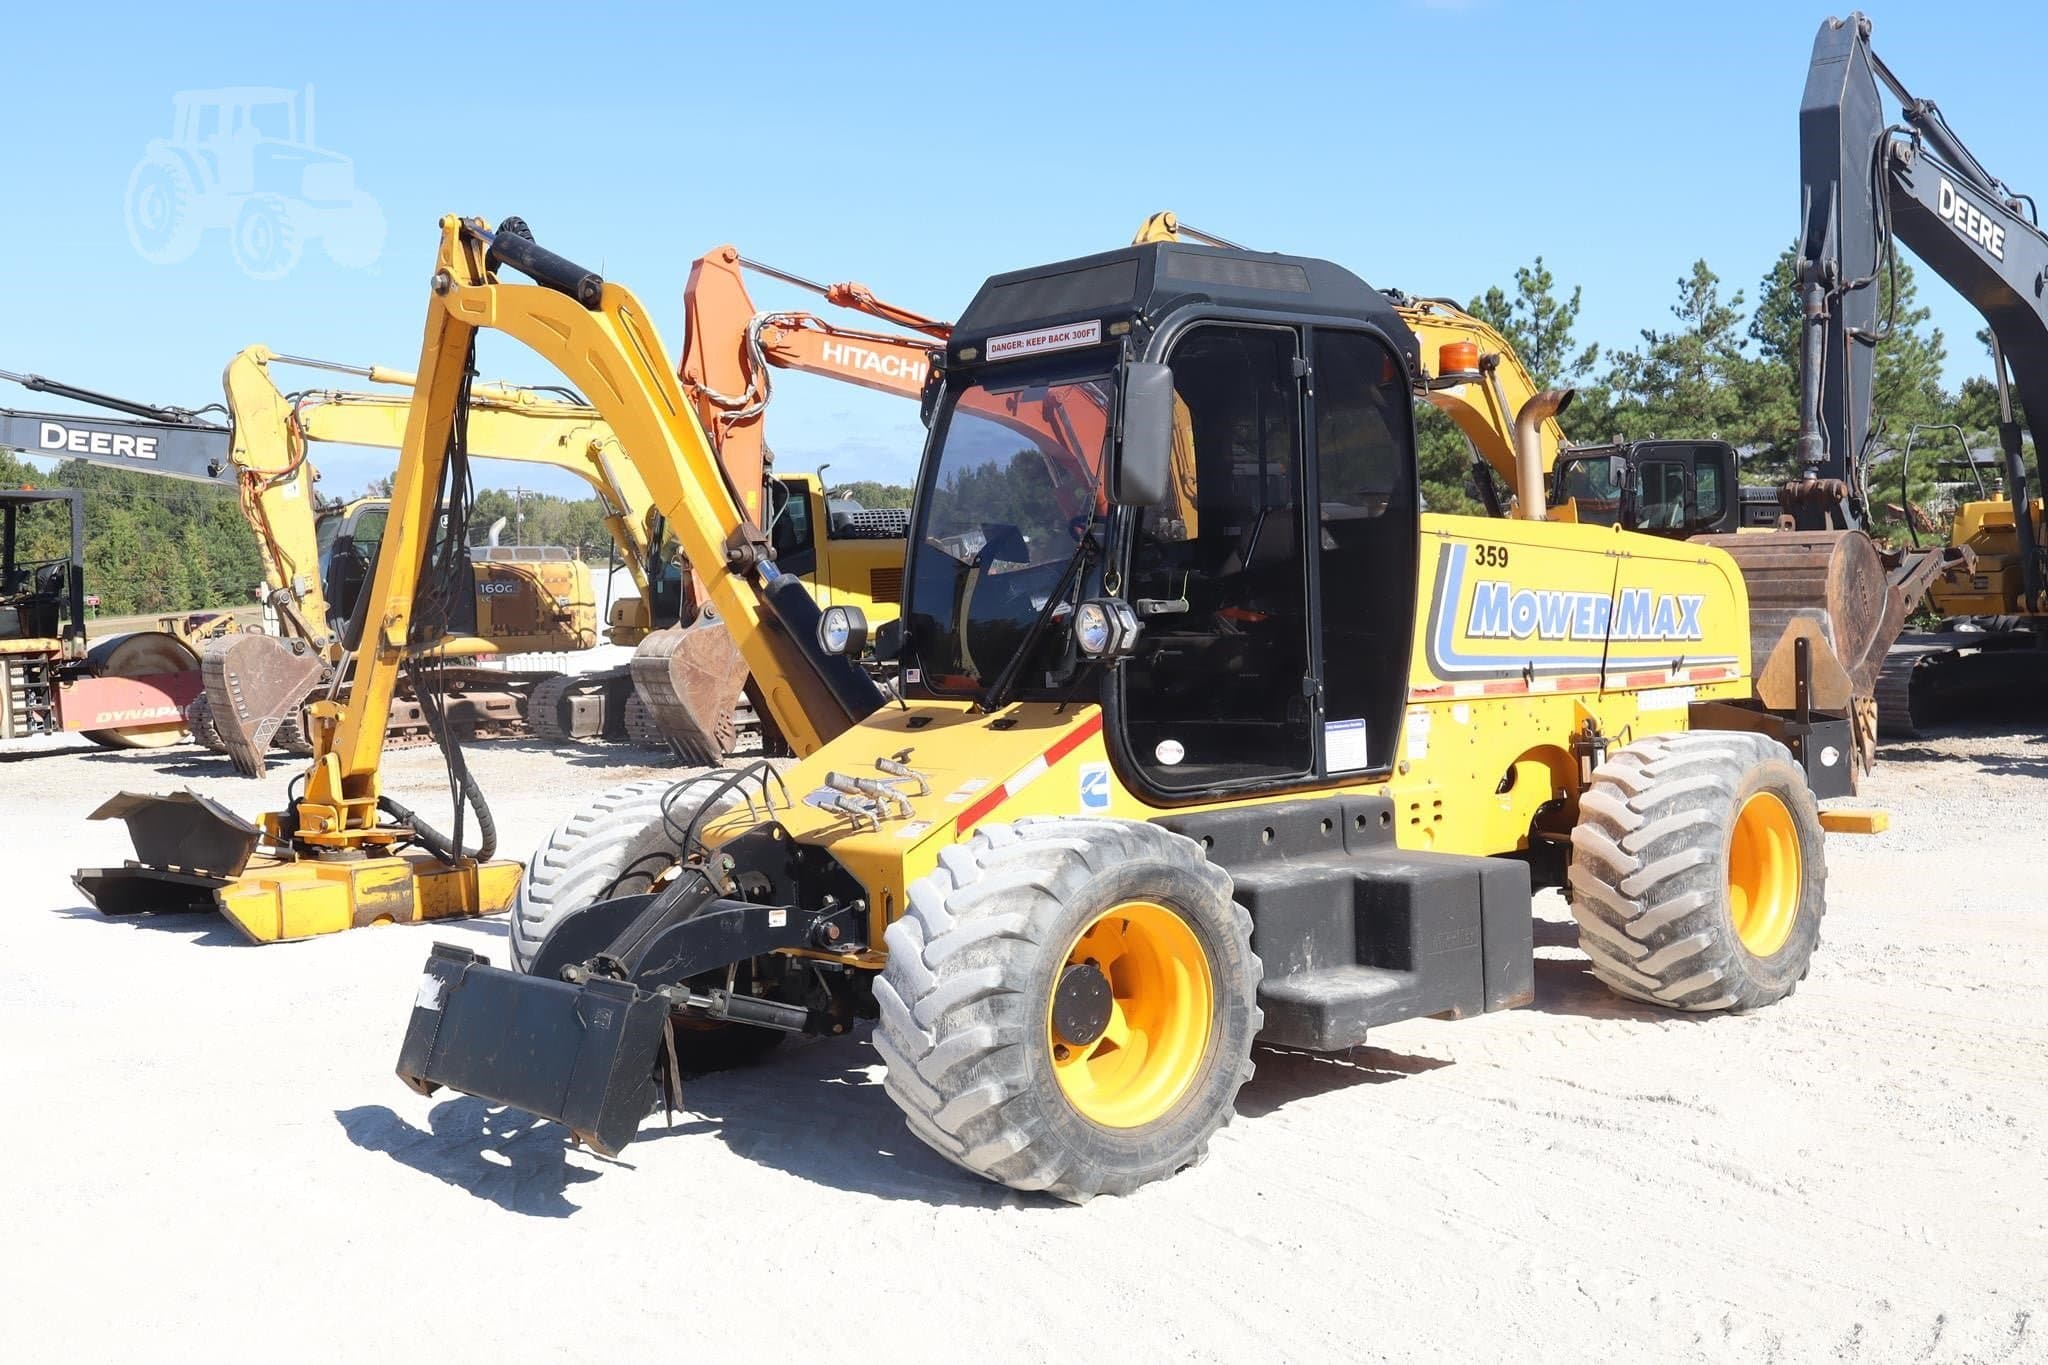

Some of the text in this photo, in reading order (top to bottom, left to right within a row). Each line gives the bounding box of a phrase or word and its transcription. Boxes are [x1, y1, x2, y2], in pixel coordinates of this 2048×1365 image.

[1938, 177, 2005, 261] DEERE
[991, 327, 1096, 353] DANGER: KEEP BACK 300FT
[822, 340, 927, 382] HITACHI
[40, 421, 158, 460] DEERE
[1475, 544, 1509, 568] 359
[480, 583, 513, 593] 160G
